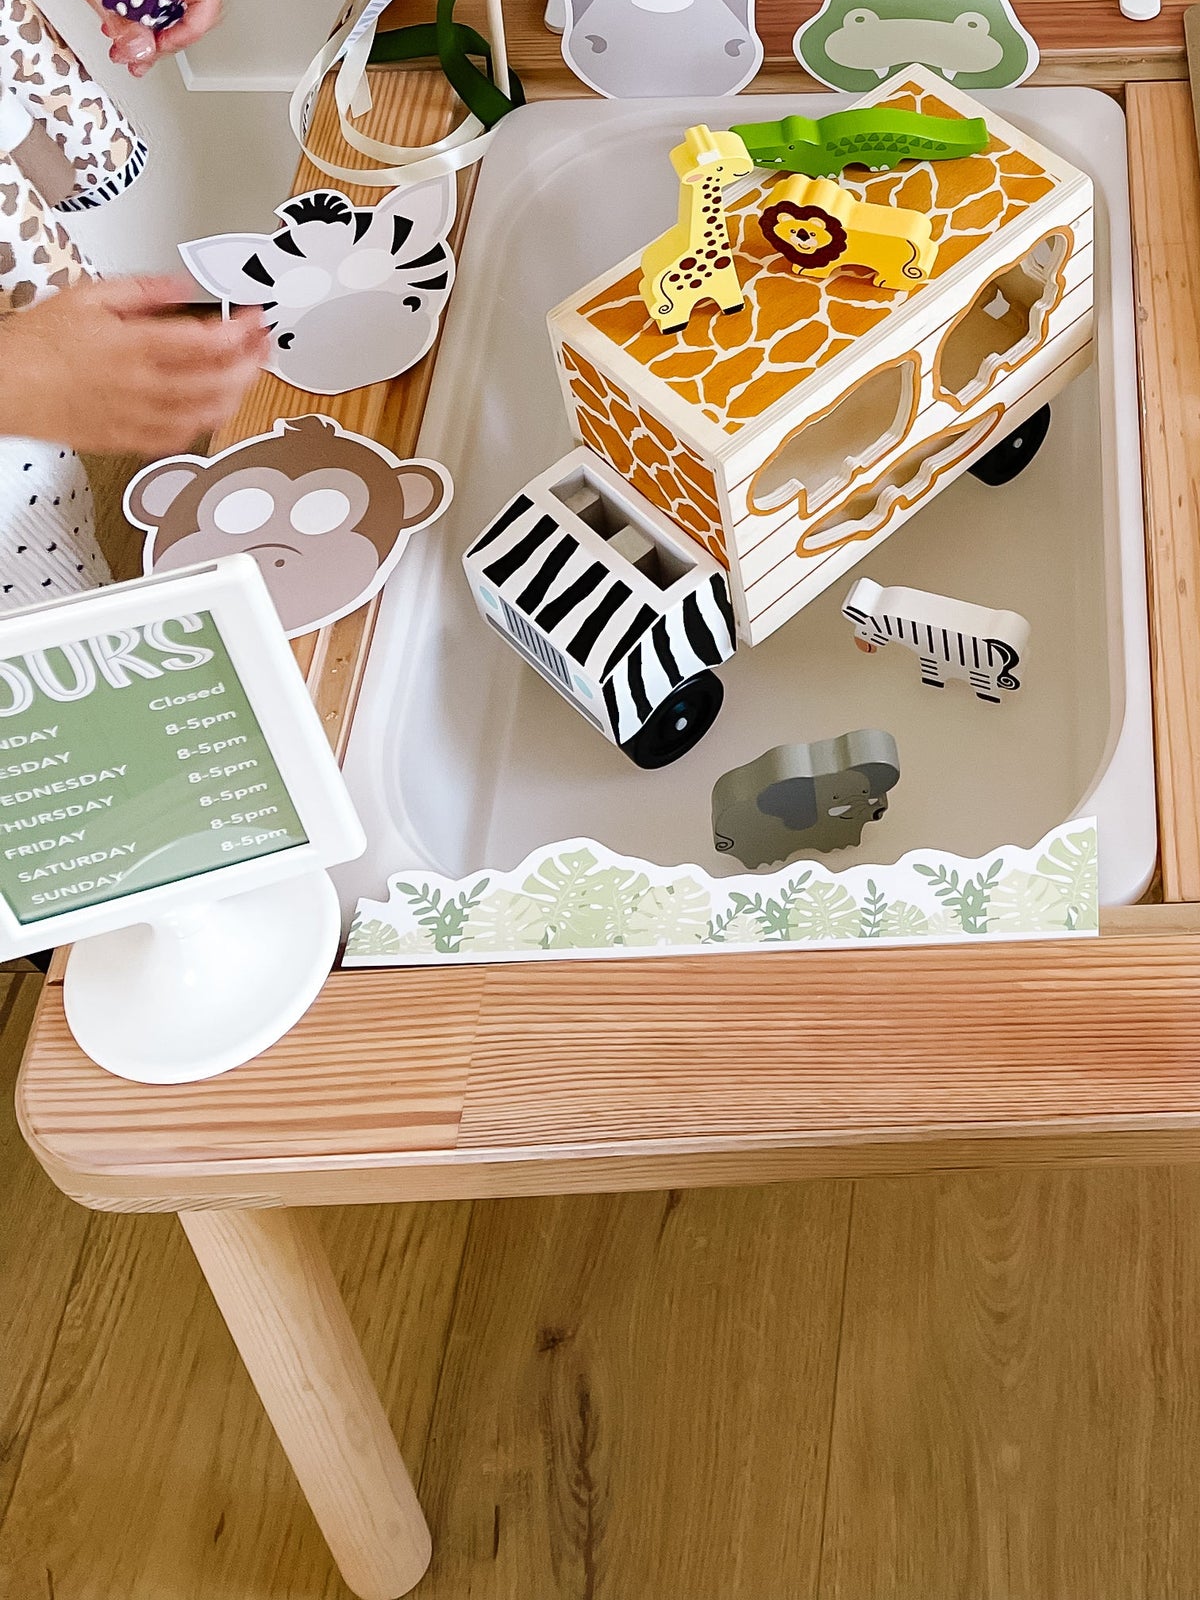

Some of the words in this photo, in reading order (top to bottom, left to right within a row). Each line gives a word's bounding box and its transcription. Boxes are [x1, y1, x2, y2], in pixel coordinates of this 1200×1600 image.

[148, 681, 226, 711] Closed
[164, 710, 237, 736] 8-5pm
[176, 735, 248, 760] 8-5pm
[187, 759, 258, 783] 8-5pm
[4, 829, 86, 860] FRIDAY
[199, 782, 268, 807] 8-5pm
[17, 841, 137, 883] SATURDAY
[210, 806, 278, 830] 8-5pm
[31, 871, 125, 905] SUNDAY
[220, 828, 288, 852] 8-5pm
